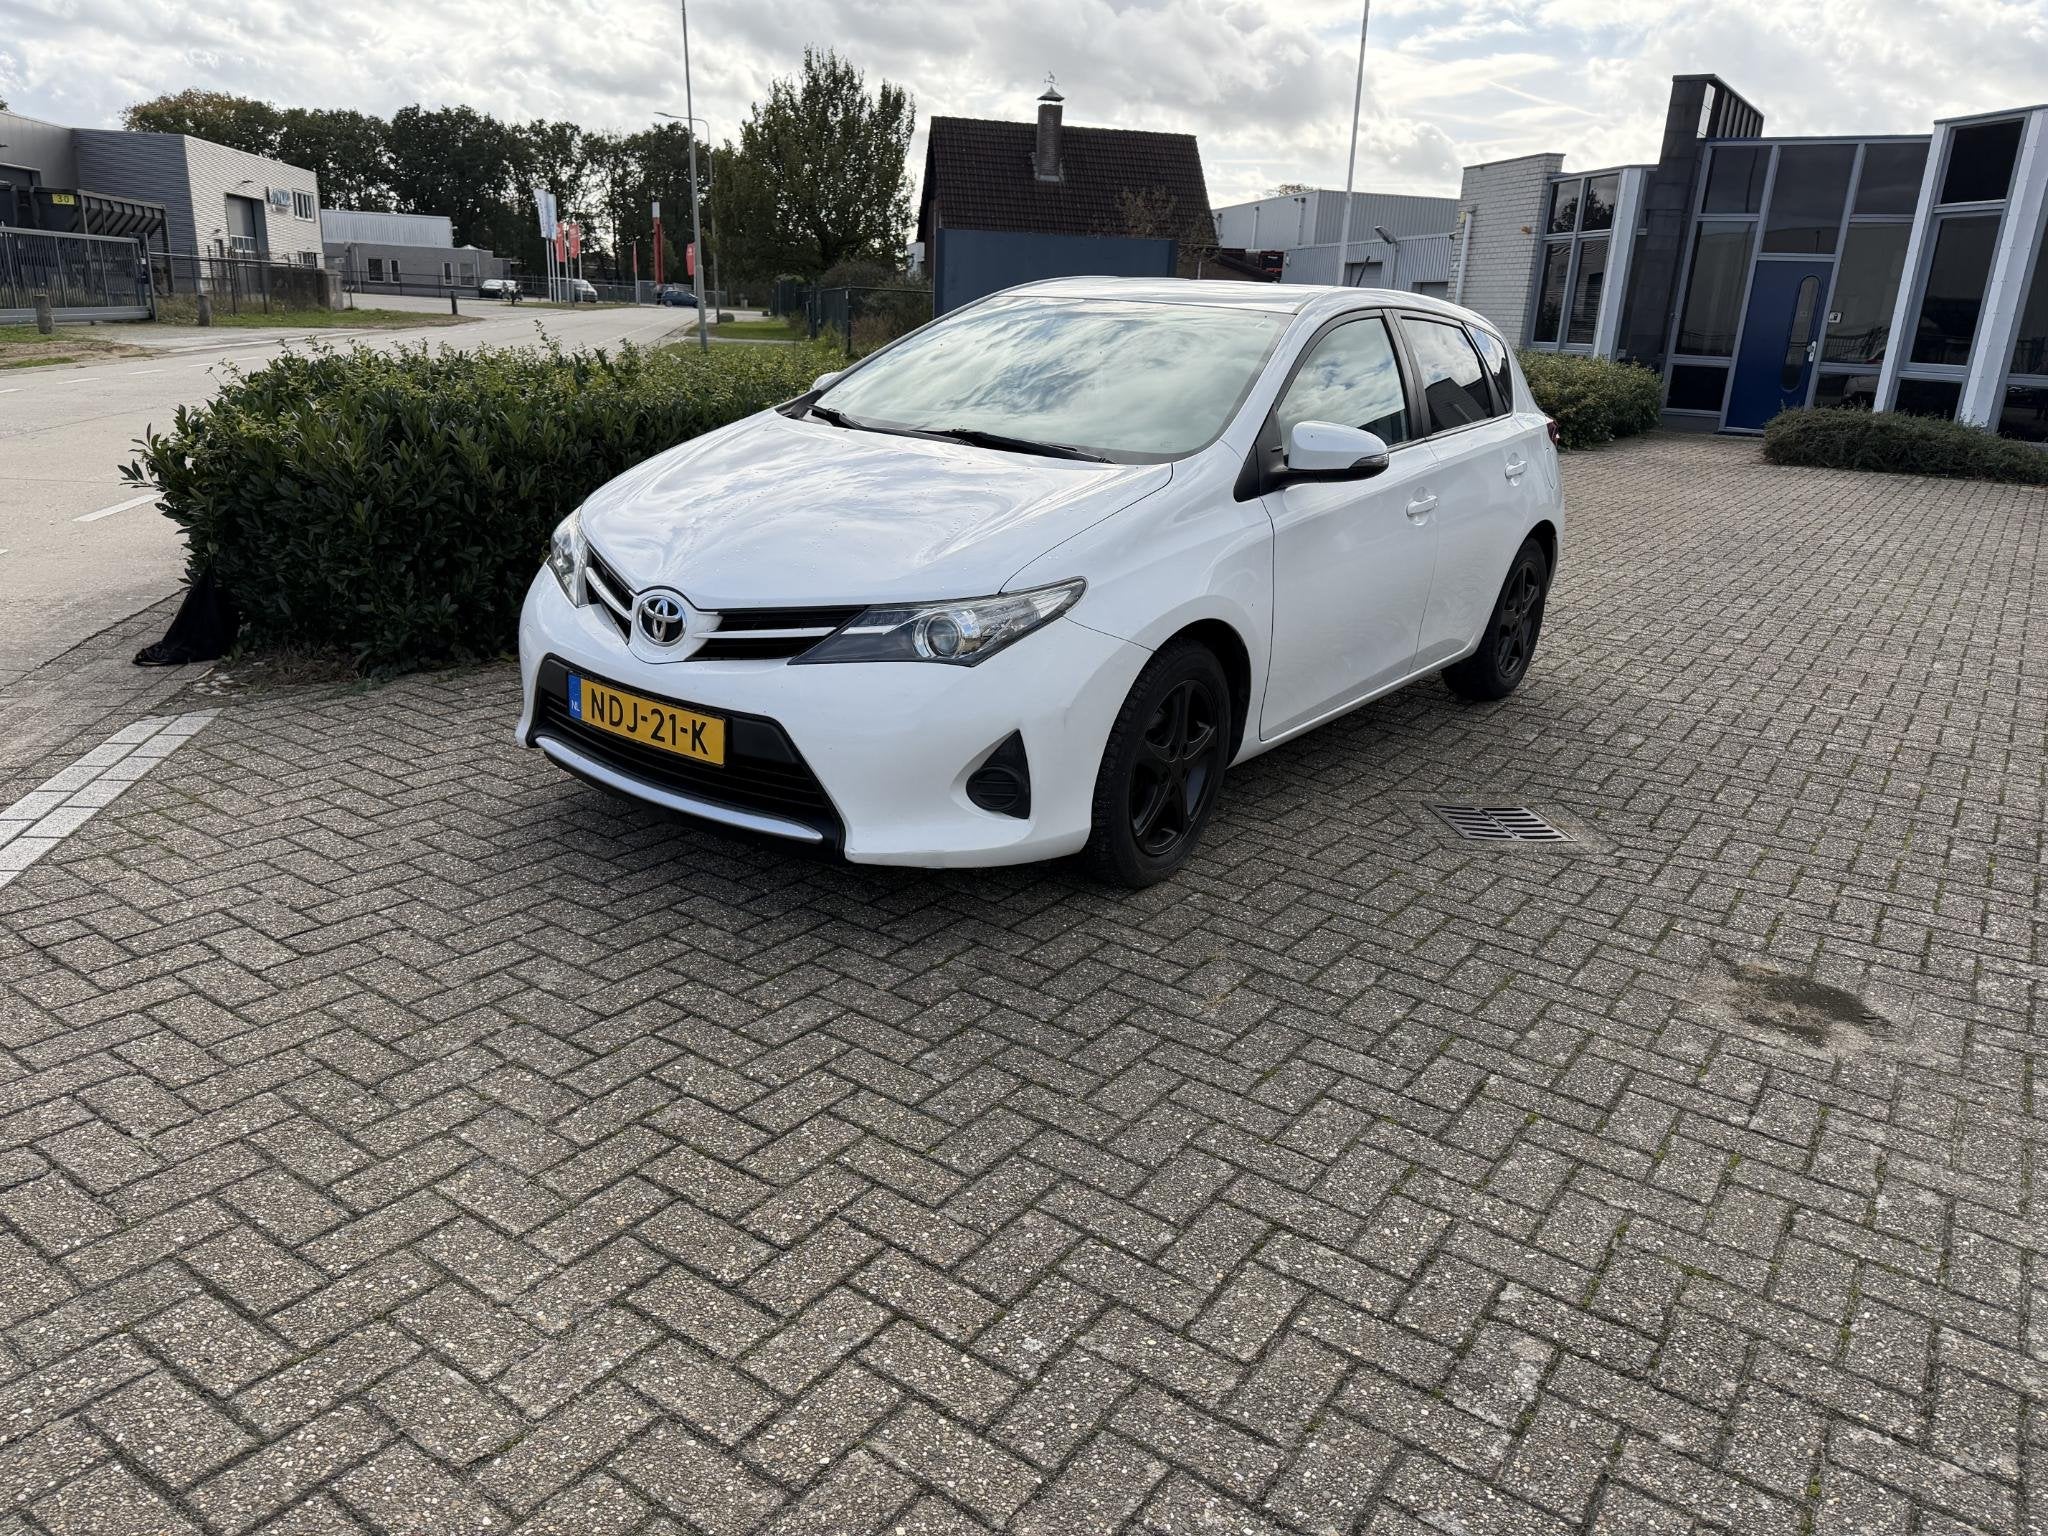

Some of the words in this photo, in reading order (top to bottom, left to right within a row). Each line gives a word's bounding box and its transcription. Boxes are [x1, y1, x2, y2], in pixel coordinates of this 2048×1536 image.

[55, 194, 70, 203] 30
[571, 699, 581, 712] NL
[590, 687, 709, 755] NDJ-21-K
